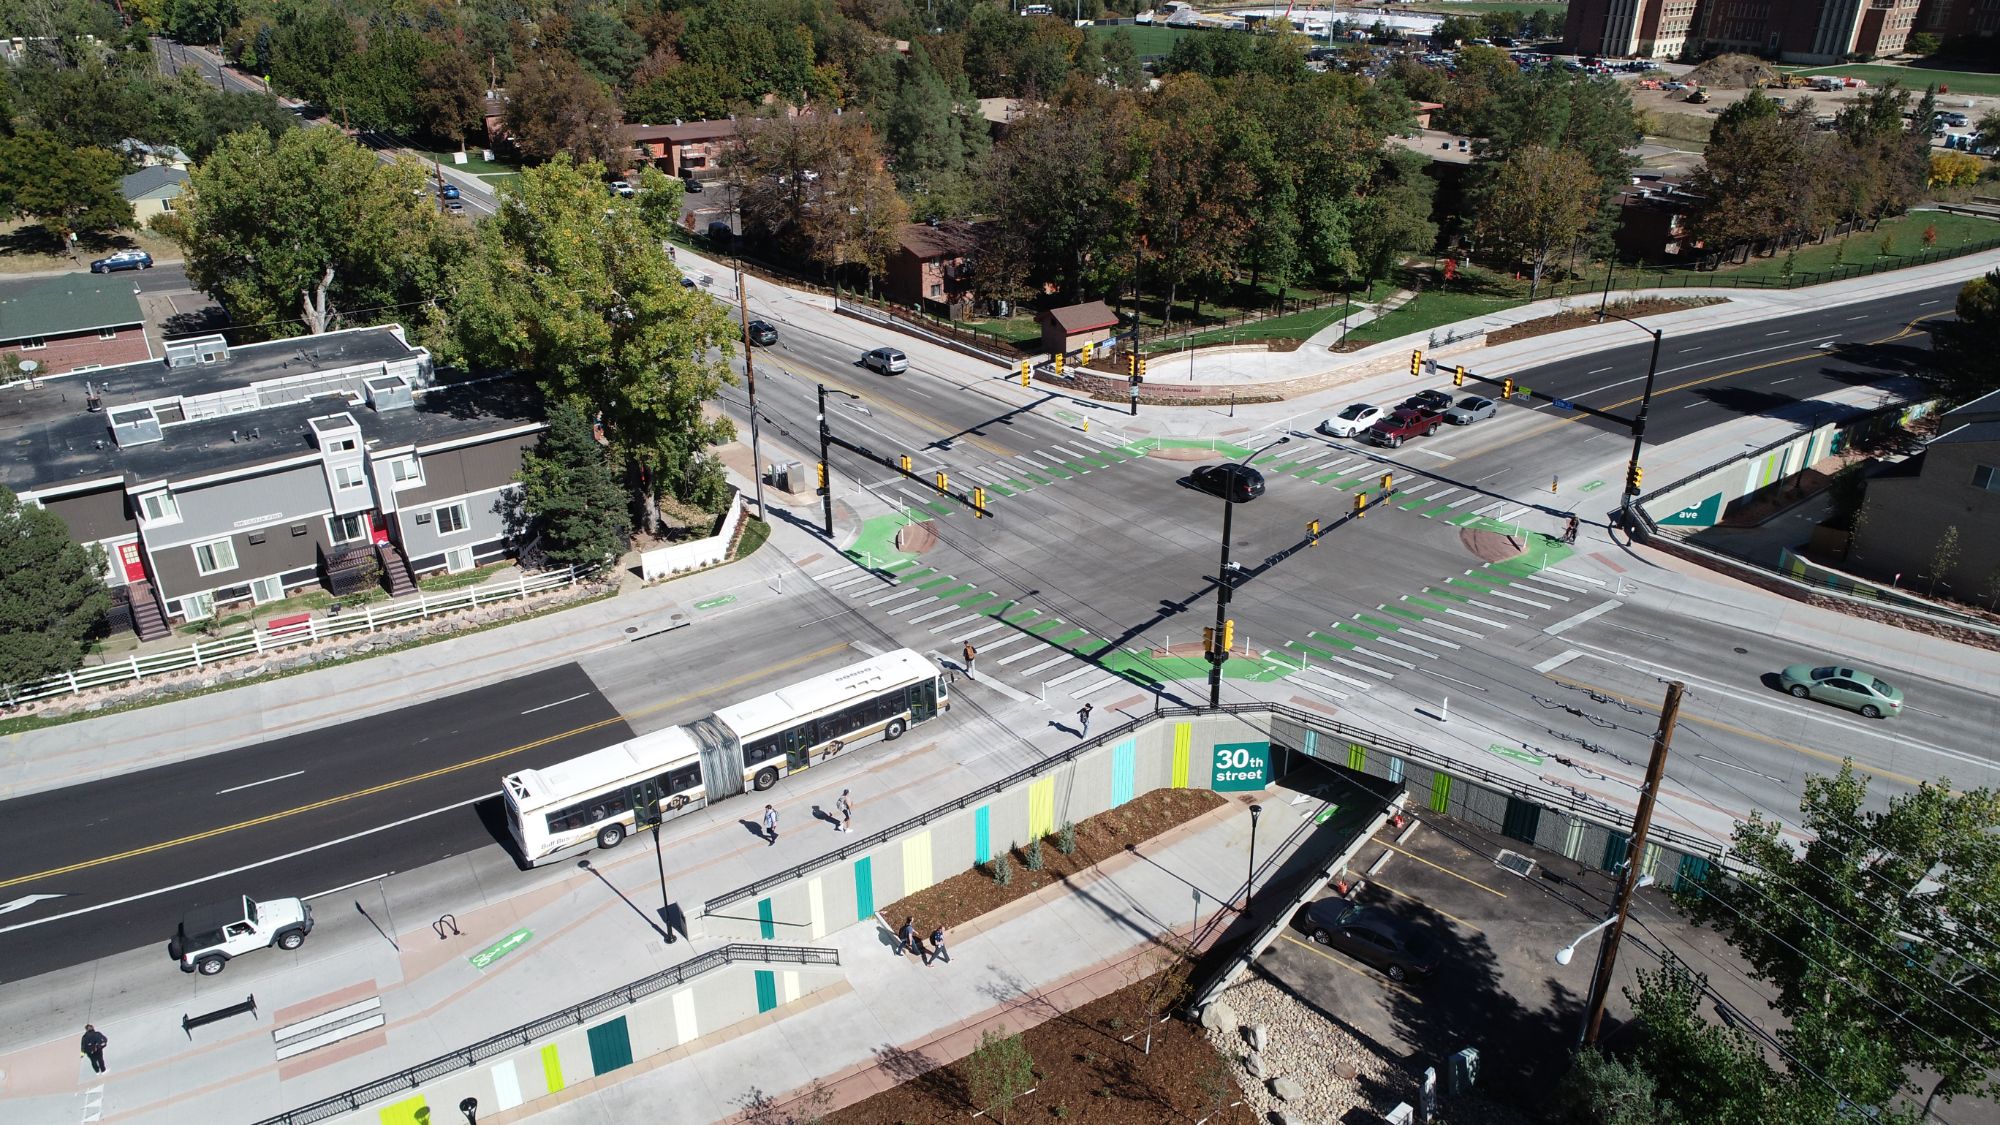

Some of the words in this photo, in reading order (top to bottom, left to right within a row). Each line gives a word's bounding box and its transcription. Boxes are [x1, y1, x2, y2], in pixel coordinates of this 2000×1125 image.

[1679, 511, 1698, 519] ave
[1216, 749, 1263, 769] 30th
[1216, 769, 1262, 781] street
